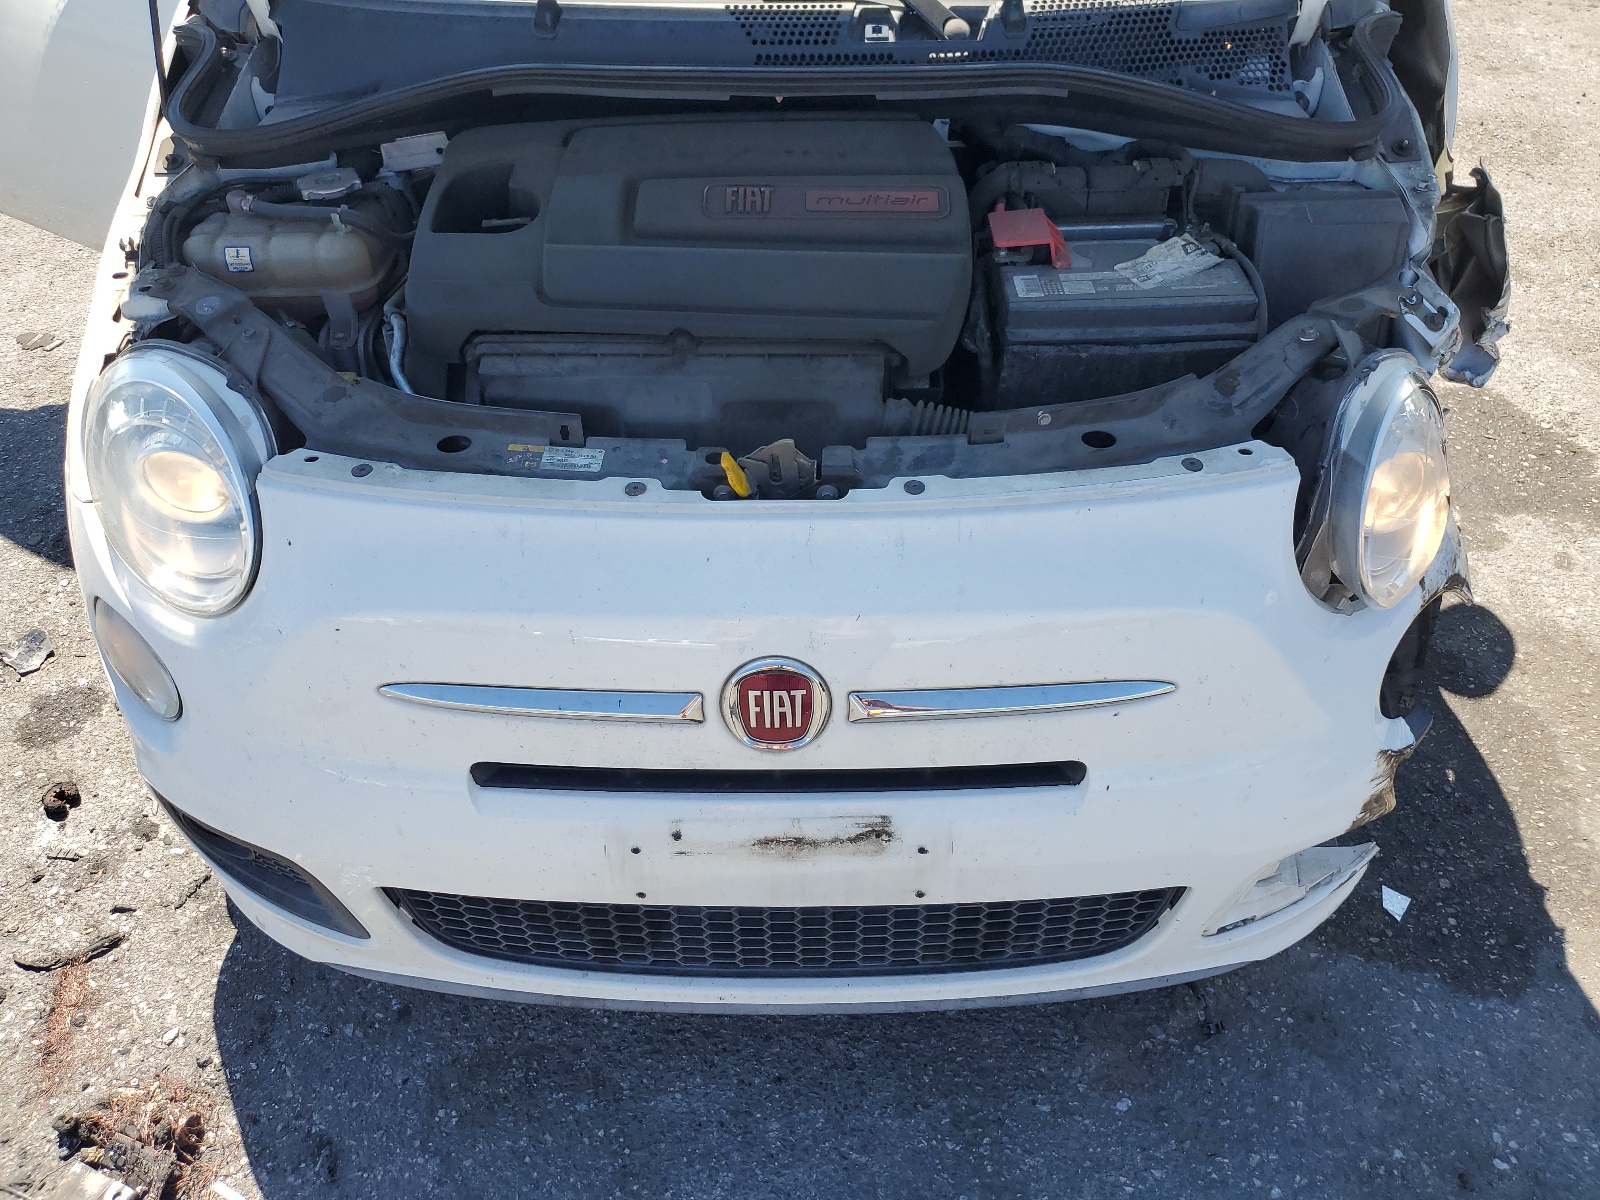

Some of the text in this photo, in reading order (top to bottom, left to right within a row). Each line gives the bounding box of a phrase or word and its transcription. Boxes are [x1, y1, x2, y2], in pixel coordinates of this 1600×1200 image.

[725, 186, 929, 214] FIAT multiair
[748, 689, 807, 729] FIAT
